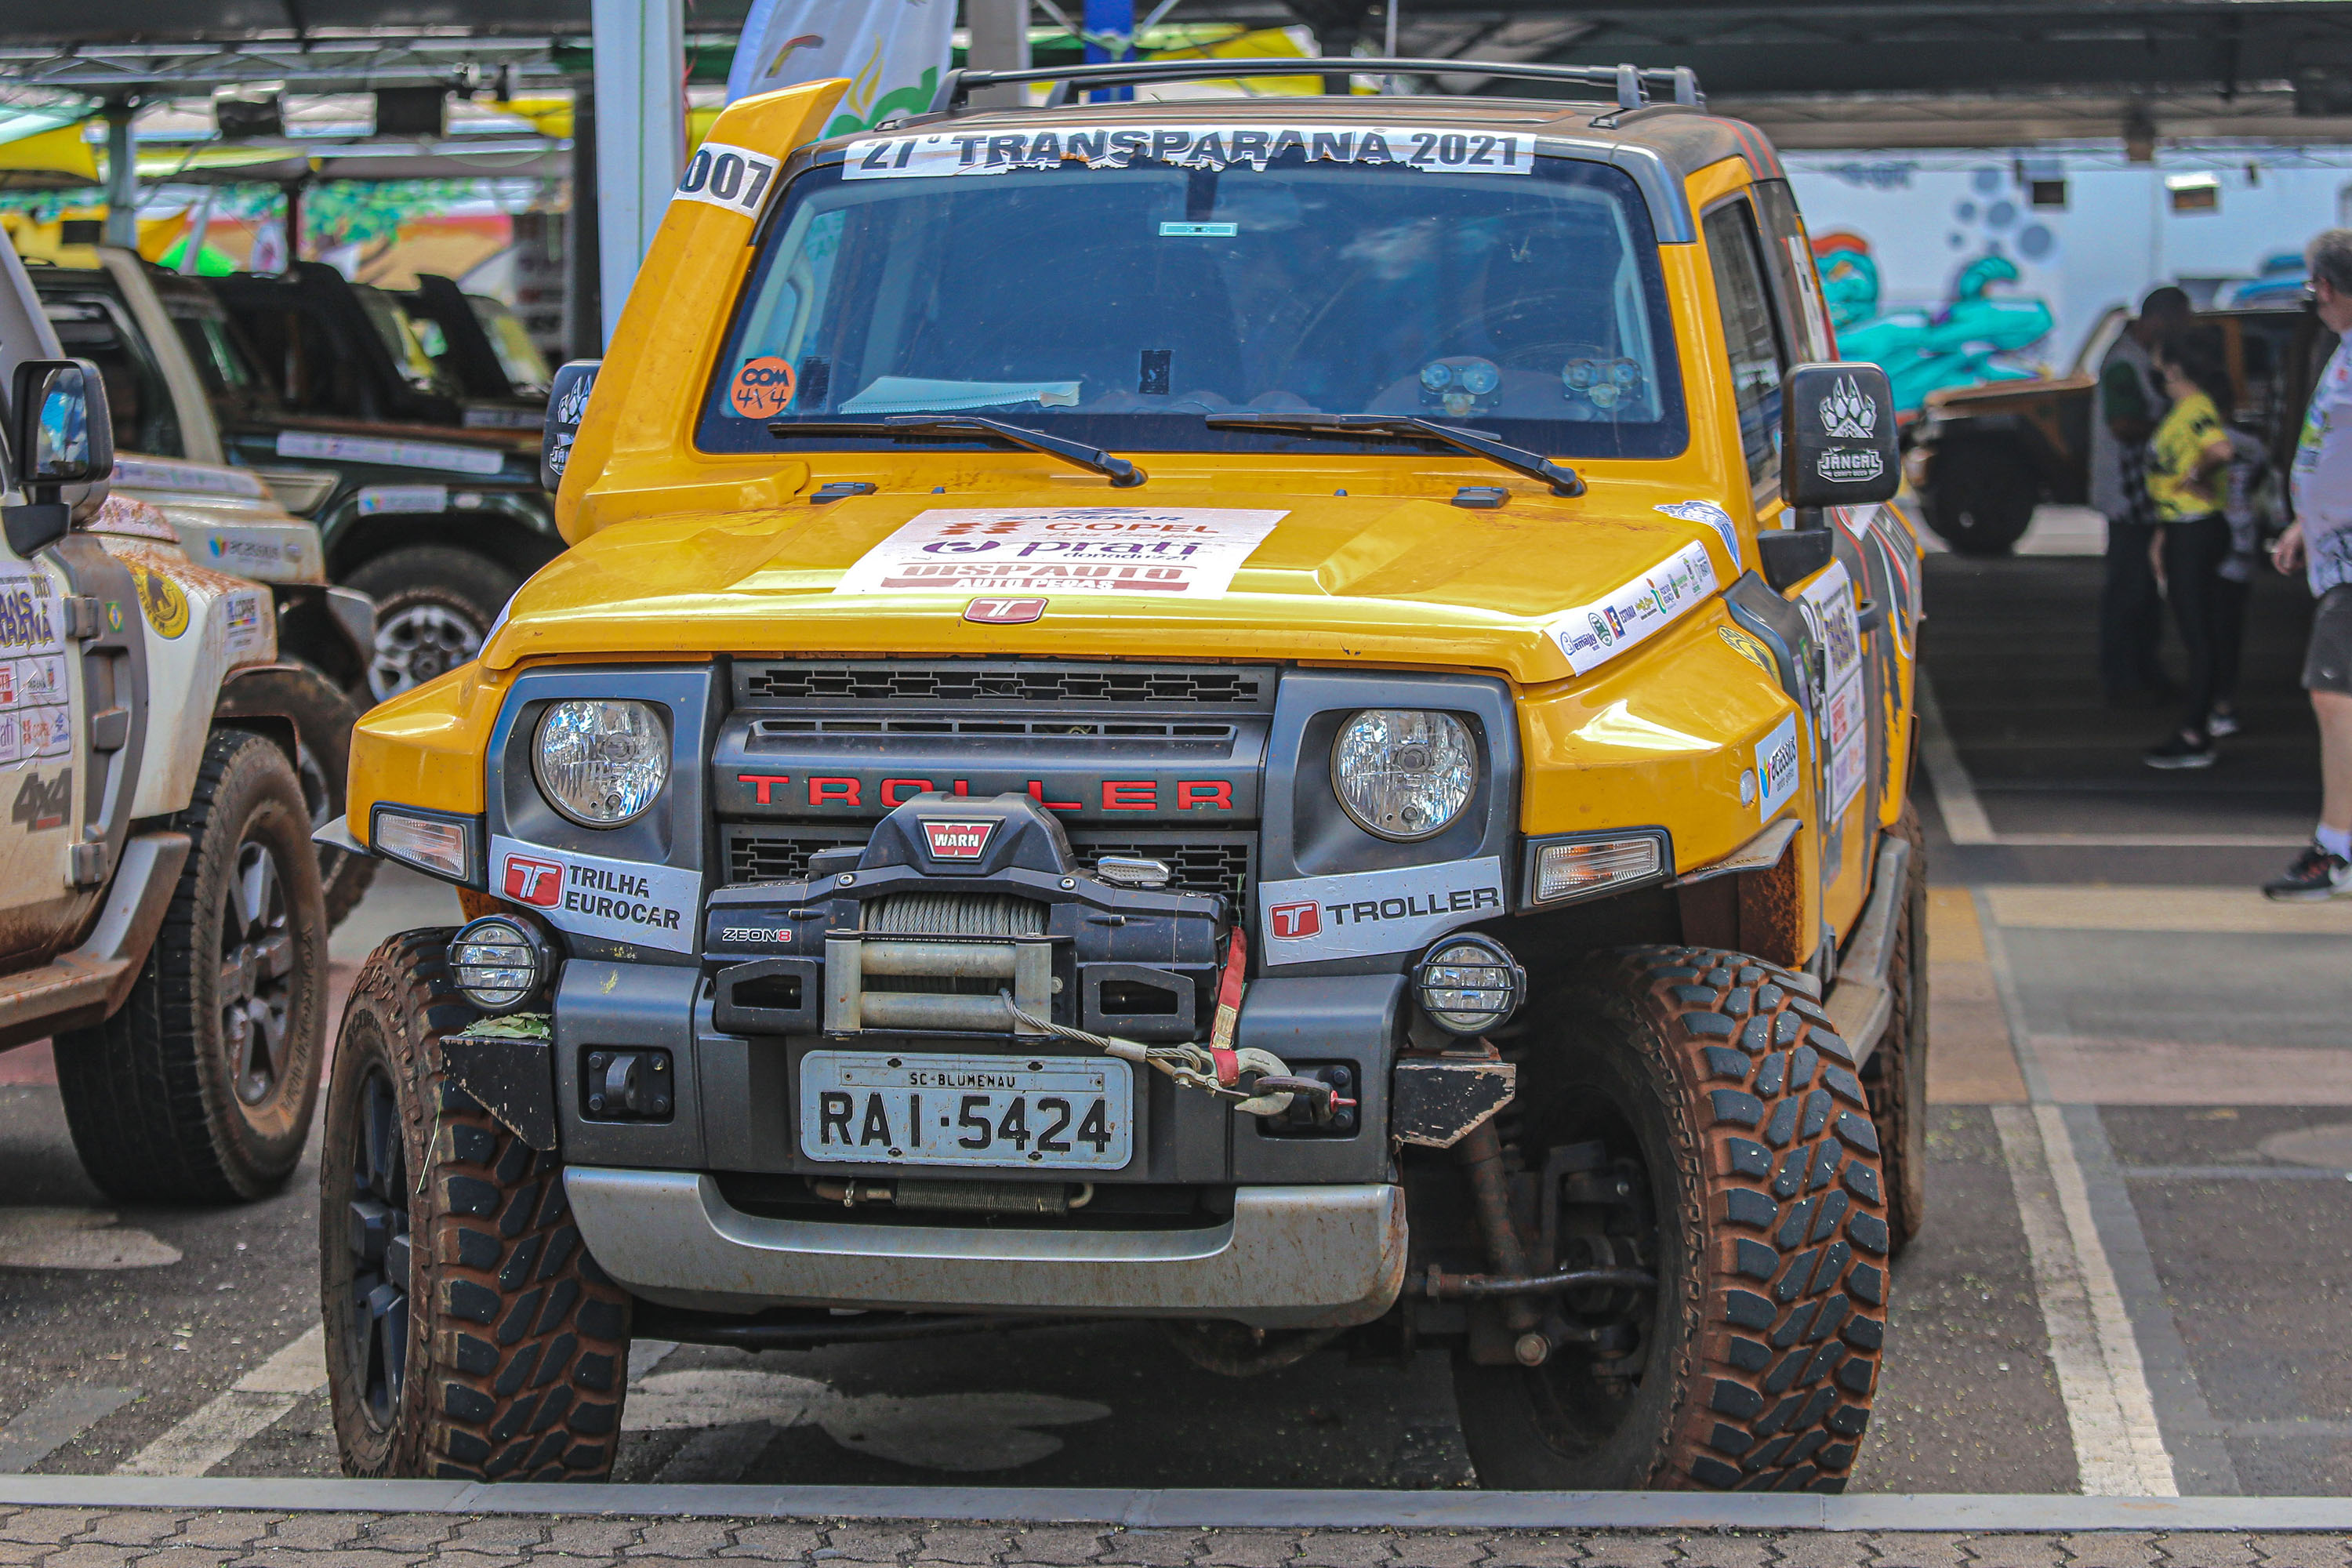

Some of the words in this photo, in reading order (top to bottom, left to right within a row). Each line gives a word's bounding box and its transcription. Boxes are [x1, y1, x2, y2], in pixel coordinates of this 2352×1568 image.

[1409, 132, 1518, 166] 2021
[676, 149, 774, 209] 007
[742, 368, 789, 387] COM
[1045, 522, 1219, 534] COPEL
[1018, 542, 1202, 557] prati
[952, 579, 1025, 588] AUTO
[934, 833, 979, 848] WARN
[569, 865, 649, 899] TRILHA
[564, 891, 681, 931] EUROCAR
[1325, 886, 1500, 926] TROLLER
[721, 927, 793, 942] ZEON8
